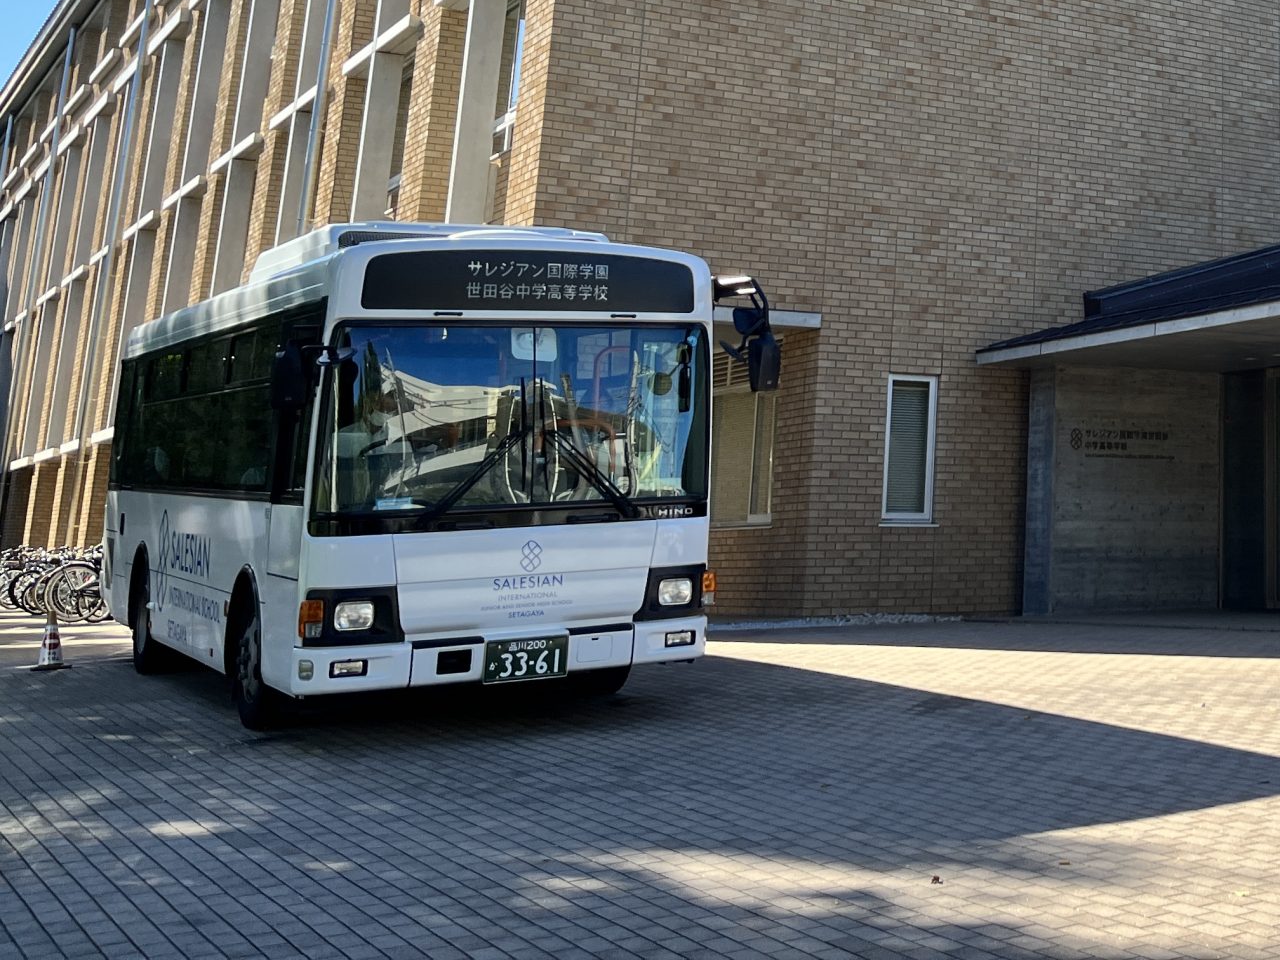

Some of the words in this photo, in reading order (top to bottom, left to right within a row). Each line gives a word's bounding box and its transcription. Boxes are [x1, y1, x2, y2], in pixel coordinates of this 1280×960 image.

[467, 260, 609, 280] サレジアン国際学園
[466, 281, 609, 301] 世田谷中学高等学校
[658, 507, 693, 516] HINO
[171, 531, 211, 578] SALESIAN
[493, 574, 563, 591] SALESIAN
[498, 592, 557, 601] INTERNATIONAL
[508, 610, 545, 618] SETAGAYA
[499, 648, 560, 678] 33-61
